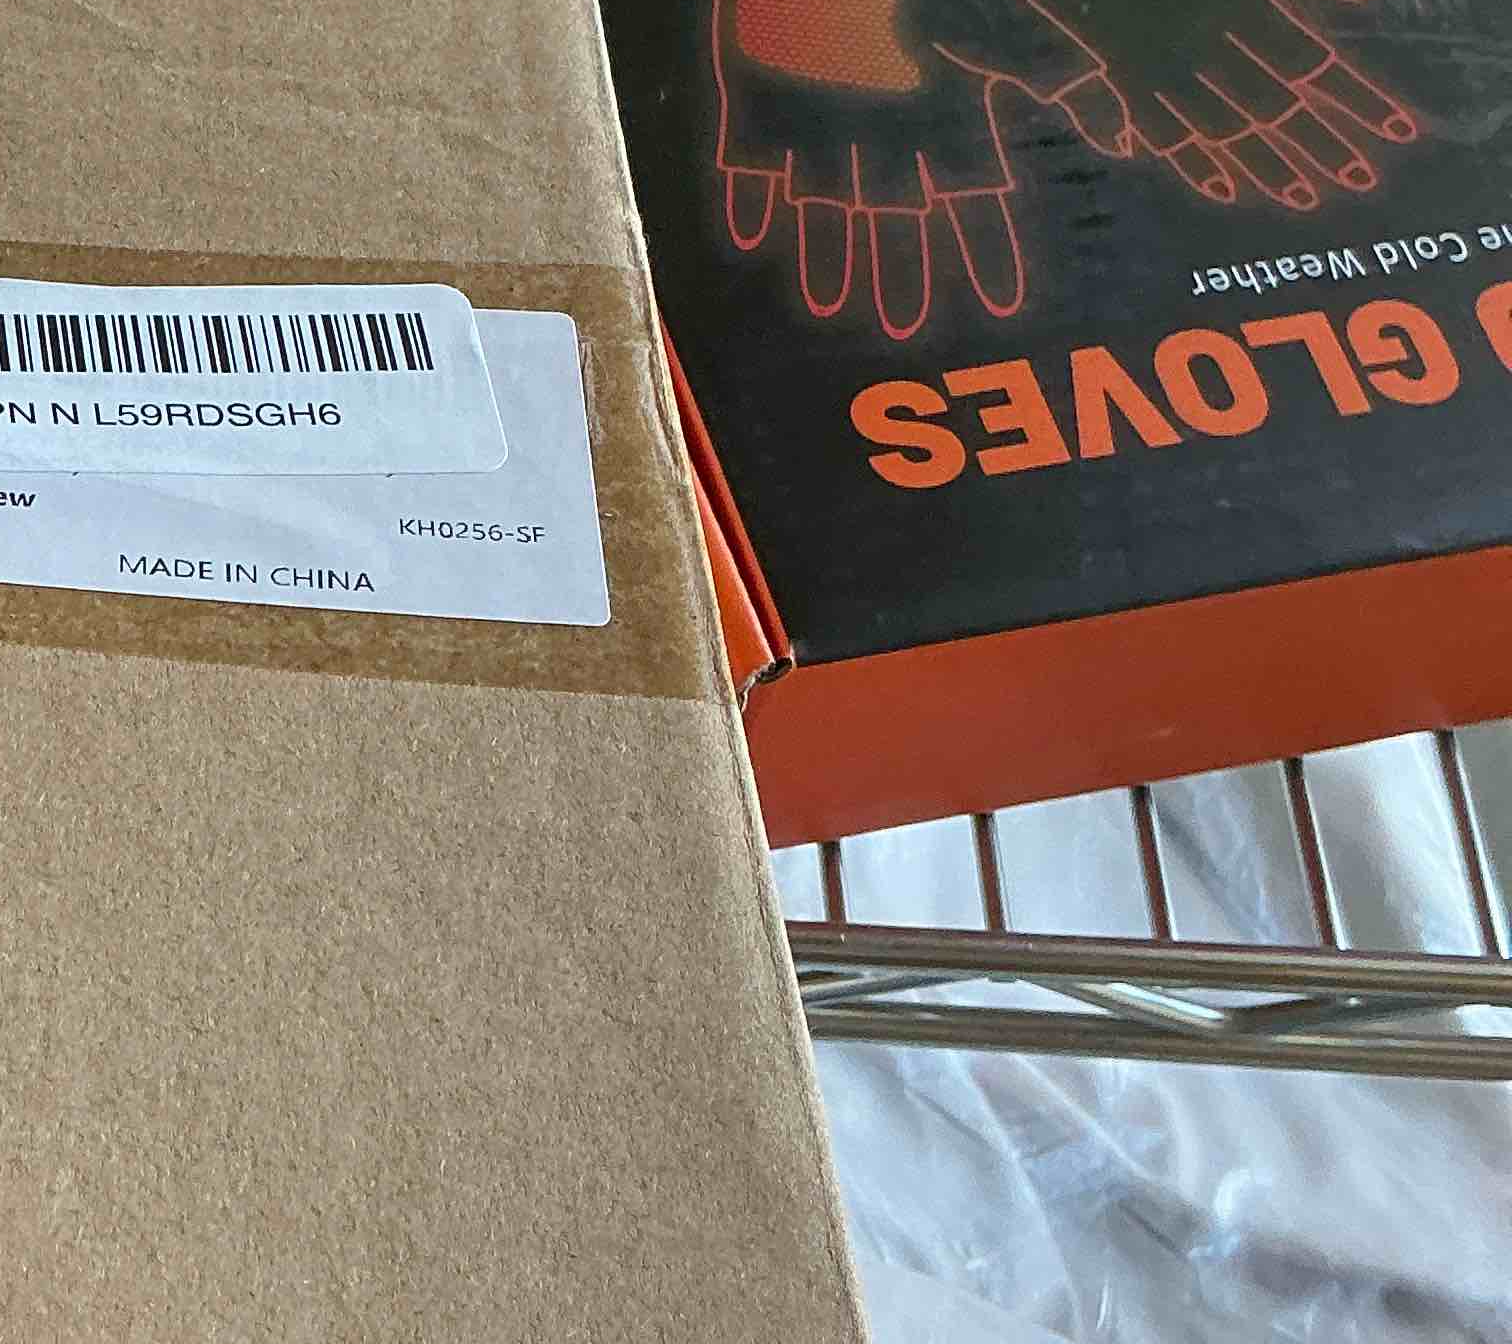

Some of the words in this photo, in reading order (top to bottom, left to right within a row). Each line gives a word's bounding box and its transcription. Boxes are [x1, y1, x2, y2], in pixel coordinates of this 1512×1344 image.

[1374, 231, 1468, 270] Cold
[1191, 248, 1366, 296] Weather
[849, 298, 1461, 489] GLOVES
[398, 517, 546, 544] KH0256-SF
[118, 554, 215, 581] MADE
[225, 562, 258, 584] IN
[270, 566, 376, 593] CHINA
